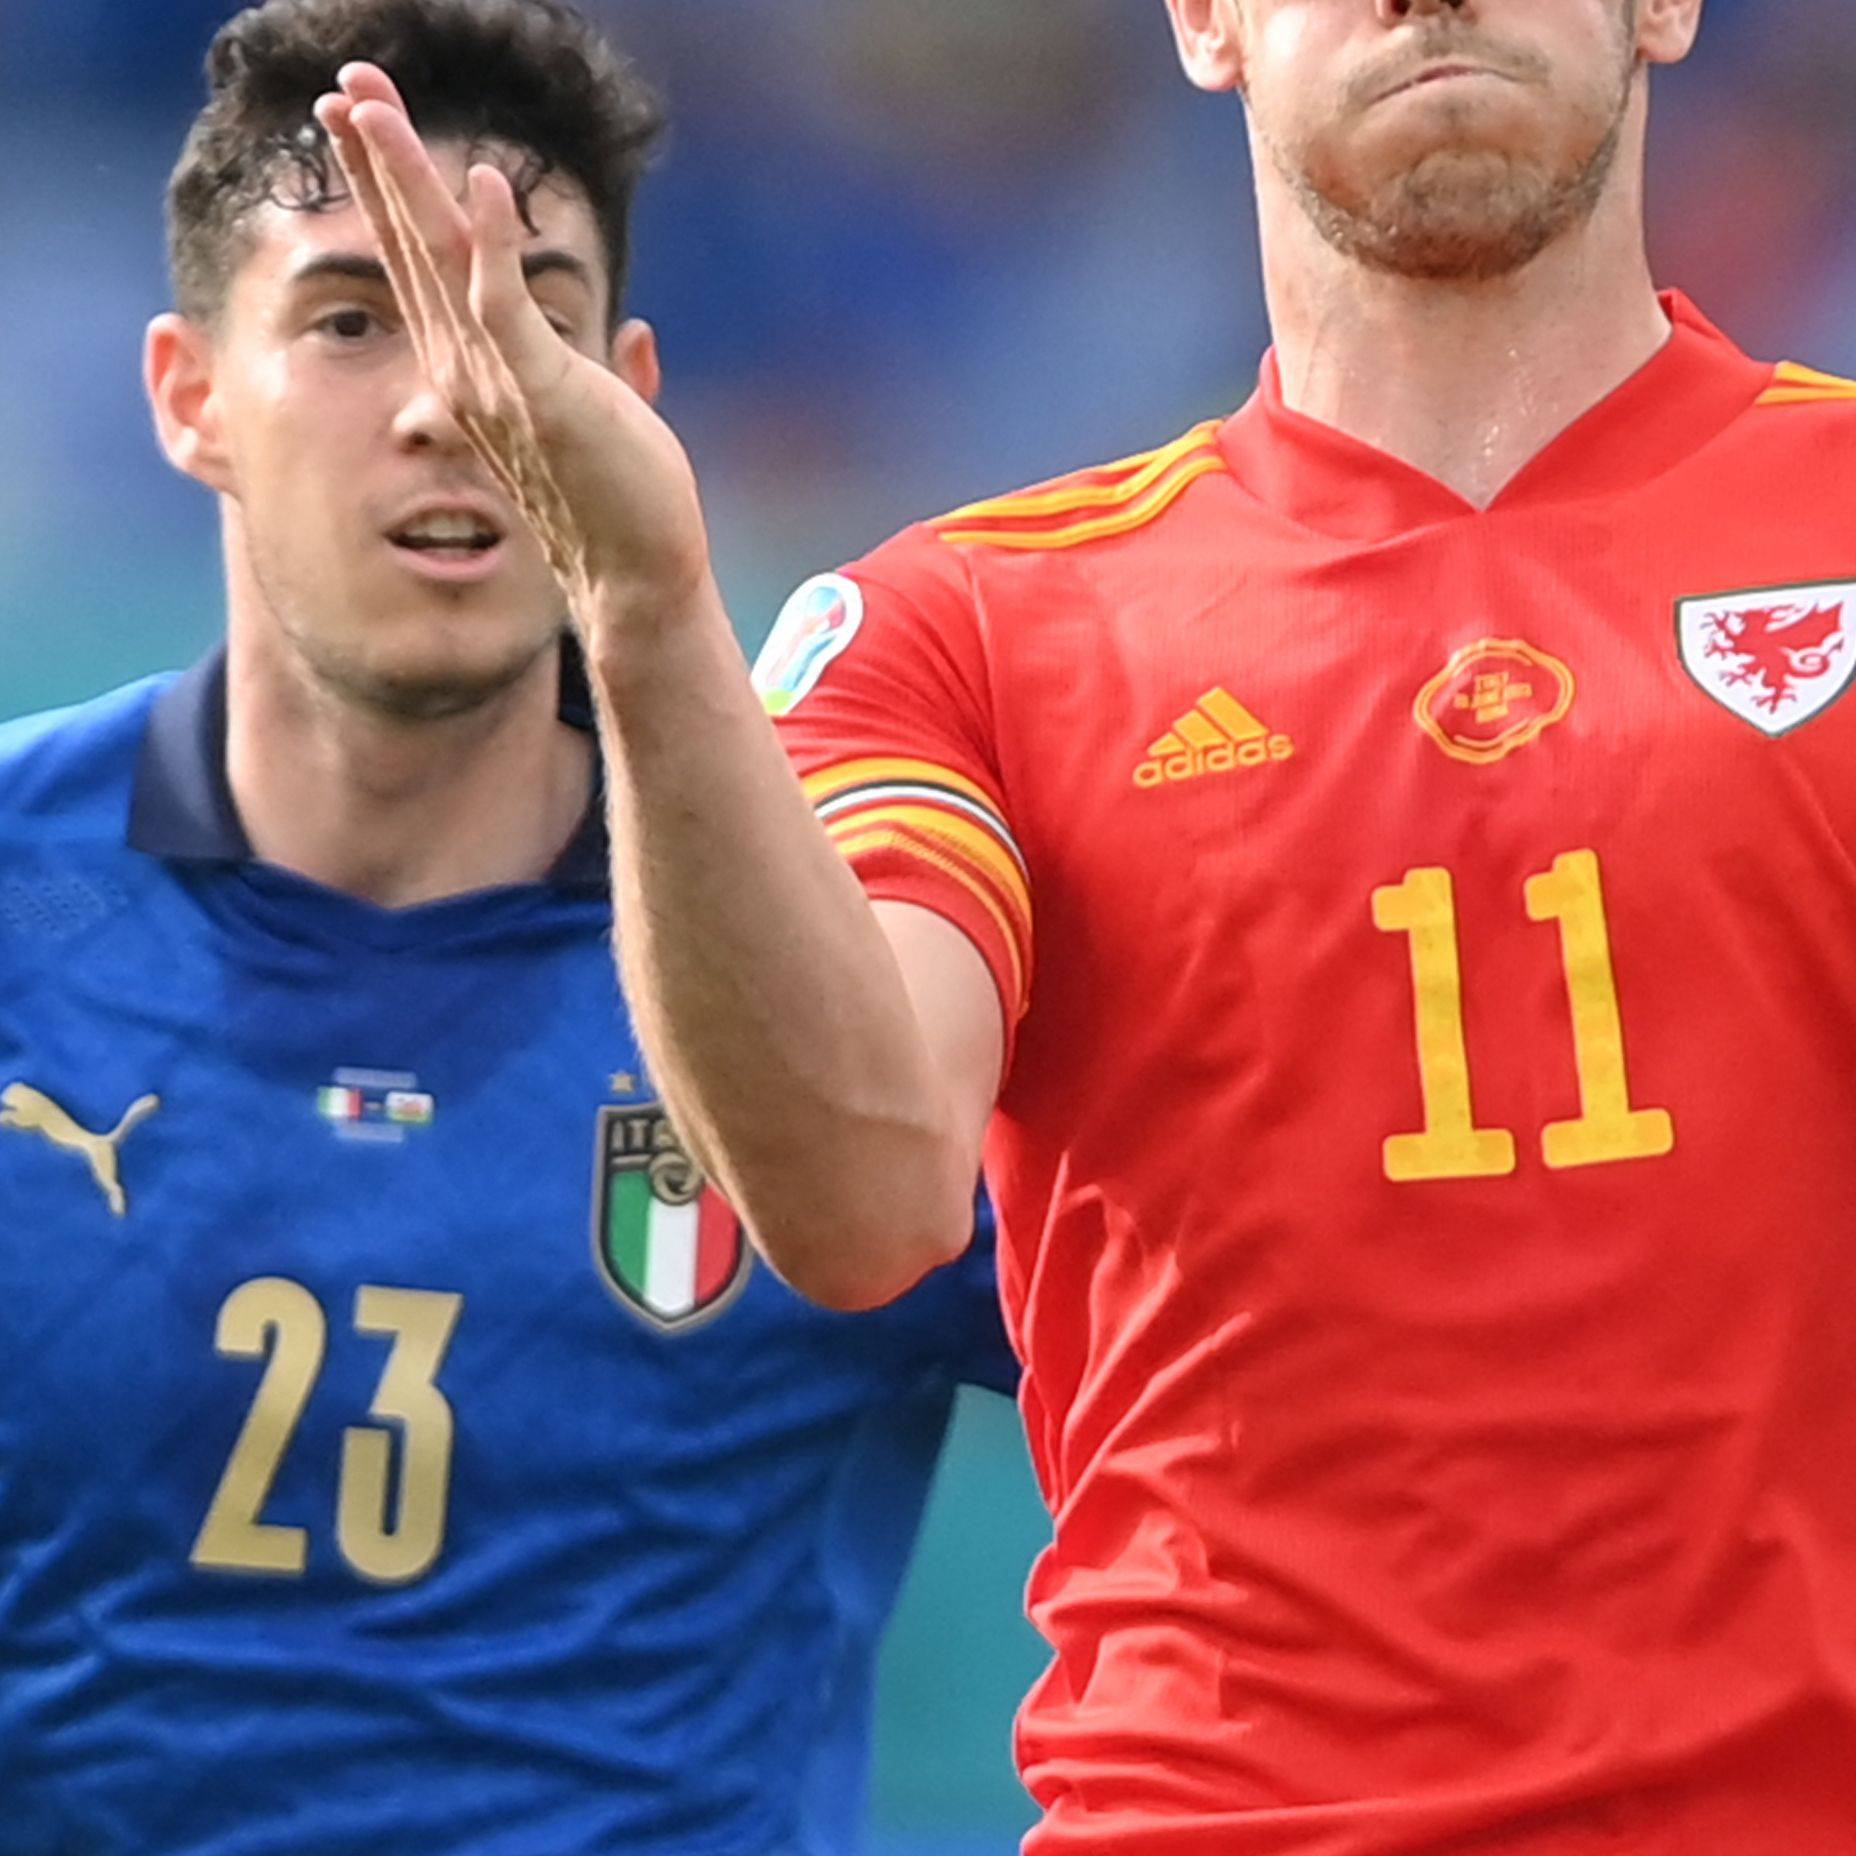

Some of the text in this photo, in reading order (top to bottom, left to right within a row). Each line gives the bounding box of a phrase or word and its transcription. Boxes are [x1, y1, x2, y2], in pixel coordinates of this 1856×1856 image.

[1131, 733, 1295, 789] adidas
[1371, 847, 1674, 1182] 11
[189, 1275, 464, 1581] 23
